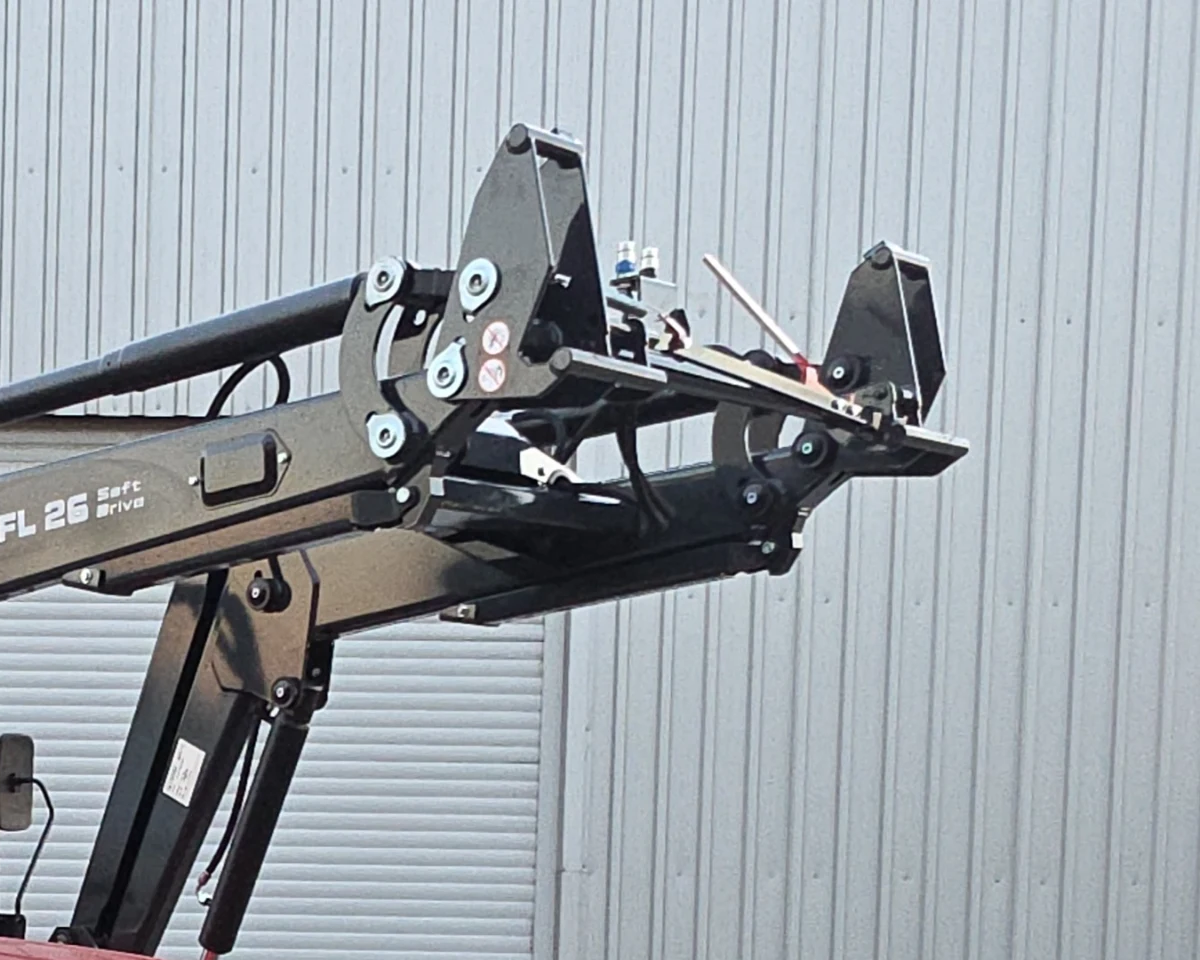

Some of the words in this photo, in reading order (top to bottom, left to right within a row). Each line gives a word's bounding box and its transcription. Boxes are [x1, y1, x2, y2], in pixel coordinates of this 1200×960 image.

[97, 480, 141, 502] Soft
[44, 492, 89, 531] 26
[96, 496, 145, 518] Drive
